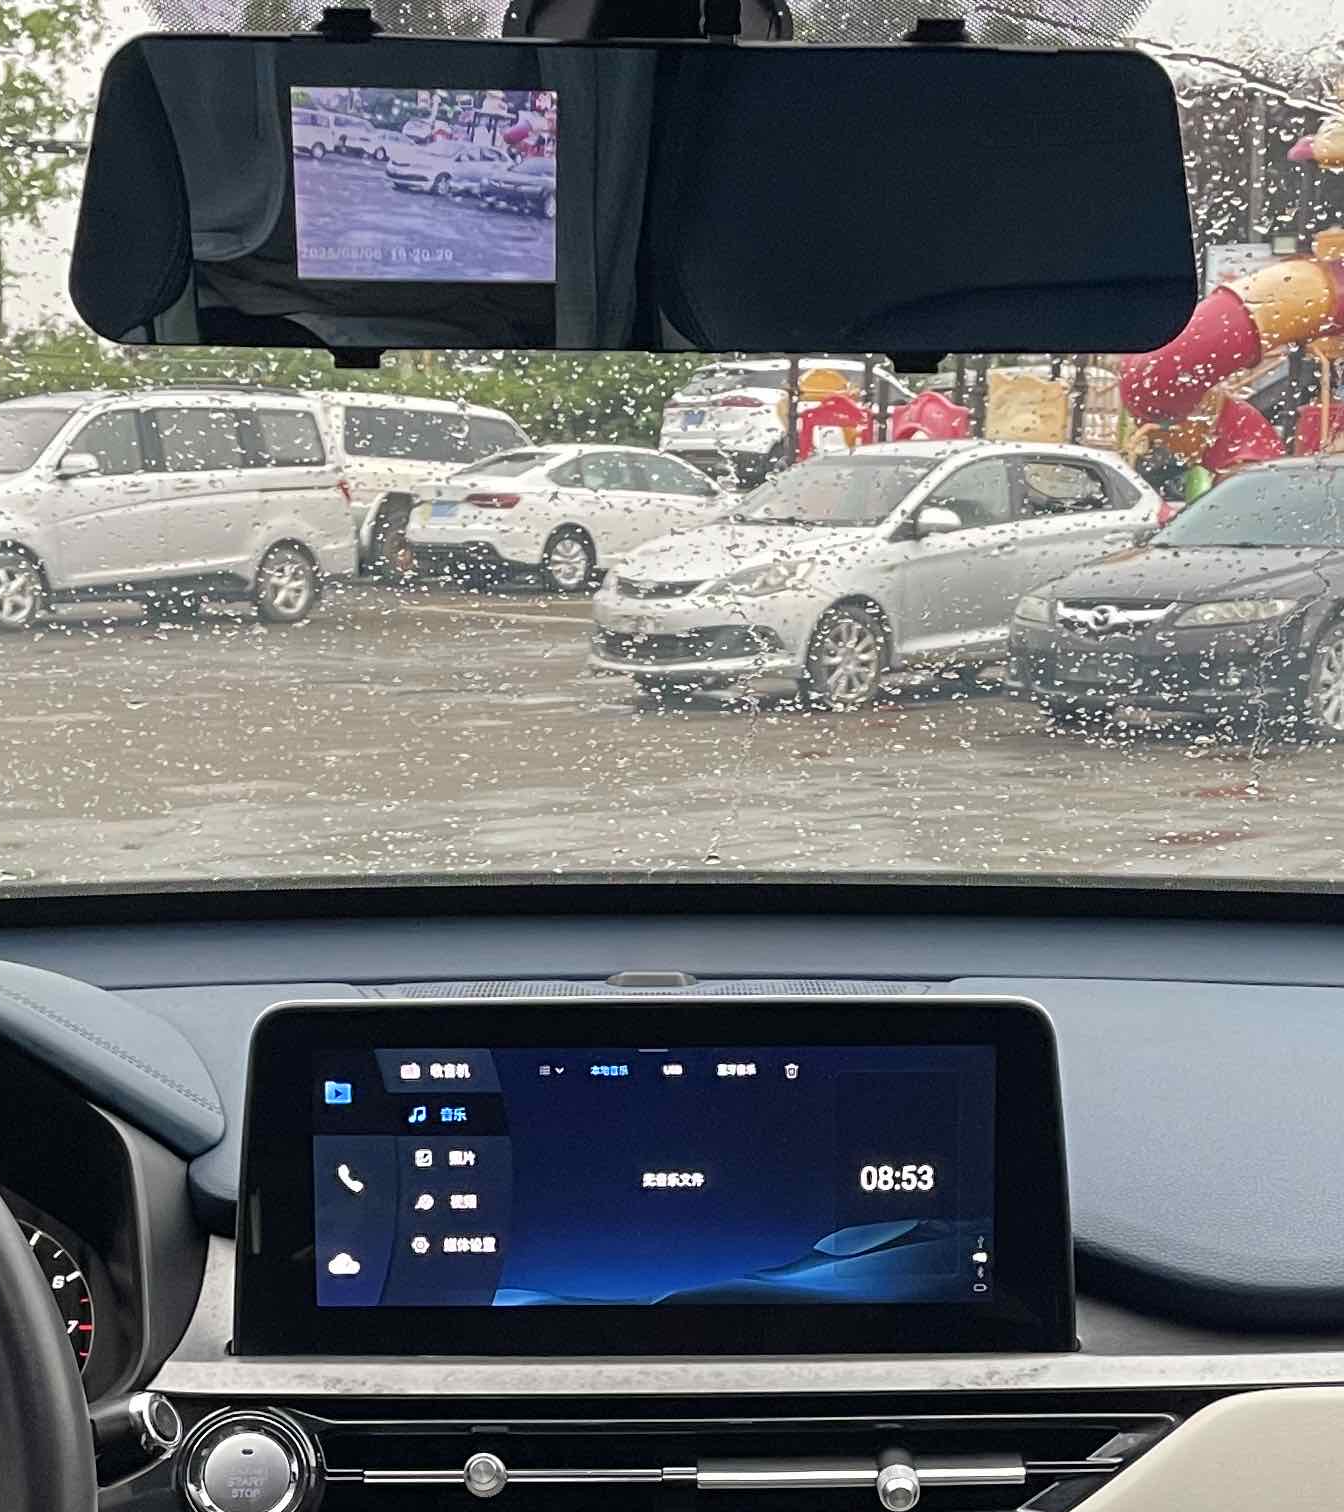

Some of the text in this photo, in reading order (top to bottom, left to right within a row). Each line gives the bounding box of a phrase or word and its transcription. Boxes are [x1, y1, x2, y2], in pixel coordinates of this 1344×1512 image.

[440, 1107, 467, 1122] 音乐
[860, 1165, 934, 1191] 08:53
[52, 1275, 65, 1289] 6
[66, 1320, 79, 1334] 7
[231, 1487, 261, 1498] STOP
